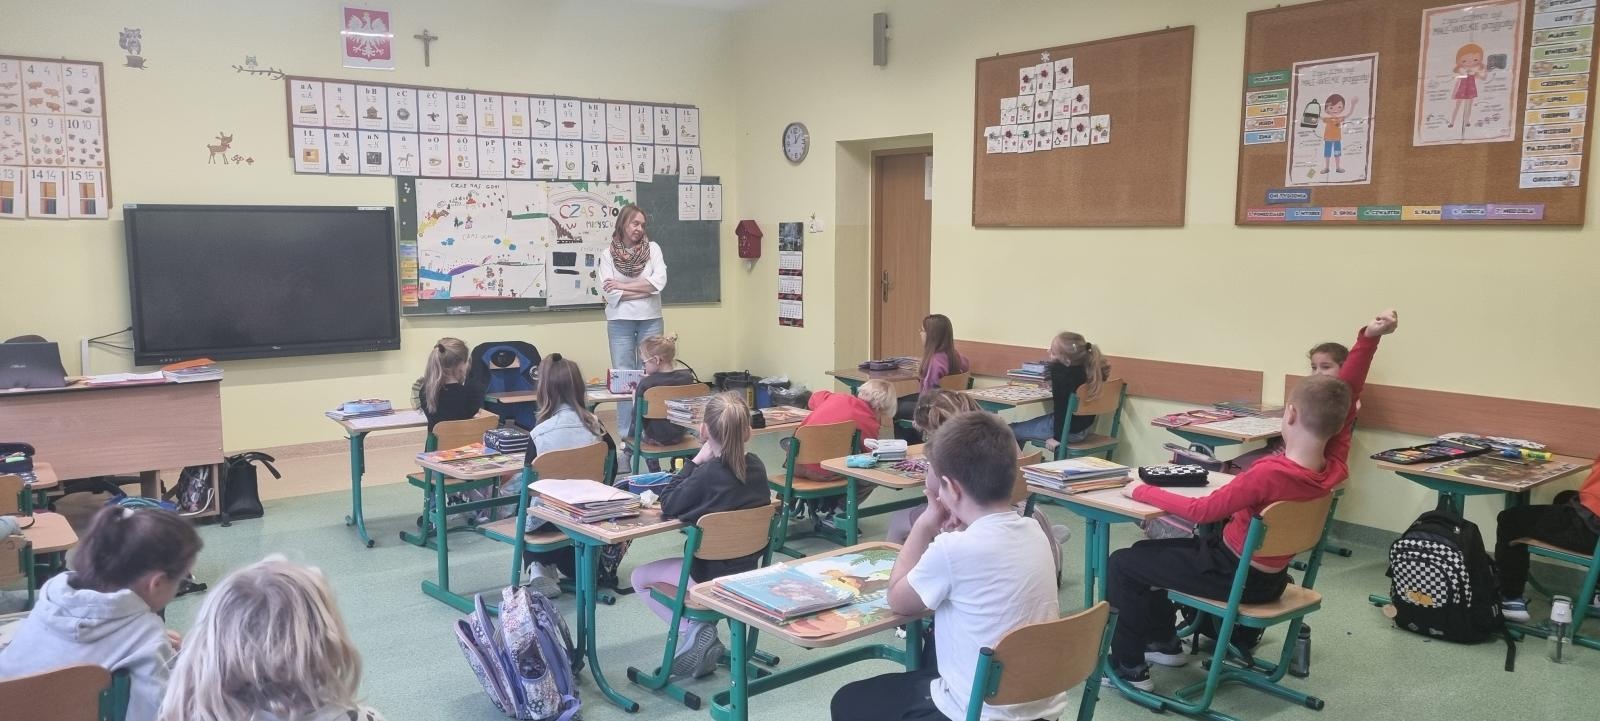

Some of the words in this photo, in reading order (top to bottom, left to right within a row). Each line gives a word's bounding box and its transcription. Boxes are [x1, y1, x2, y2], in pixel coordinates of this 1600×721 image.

[28, 65, 34, 74] 4
[66, 67, 72, 76] 5
[82, 68, 88, 78] 5
[31, 118, 38, 126] 9
[48, 119, 53, 128] 9
[68, 120, 79, 128] 10
[82, 120, 92, 129] 10
[32, 170, 43, 179] 14
[47, 170, 56, 179] 14
[71, 171, 82, 180] 15
[85, 172, 94, 180] 15
[560, 204, 594, 218] CZAS
[601, 205, 619, 217] STO
